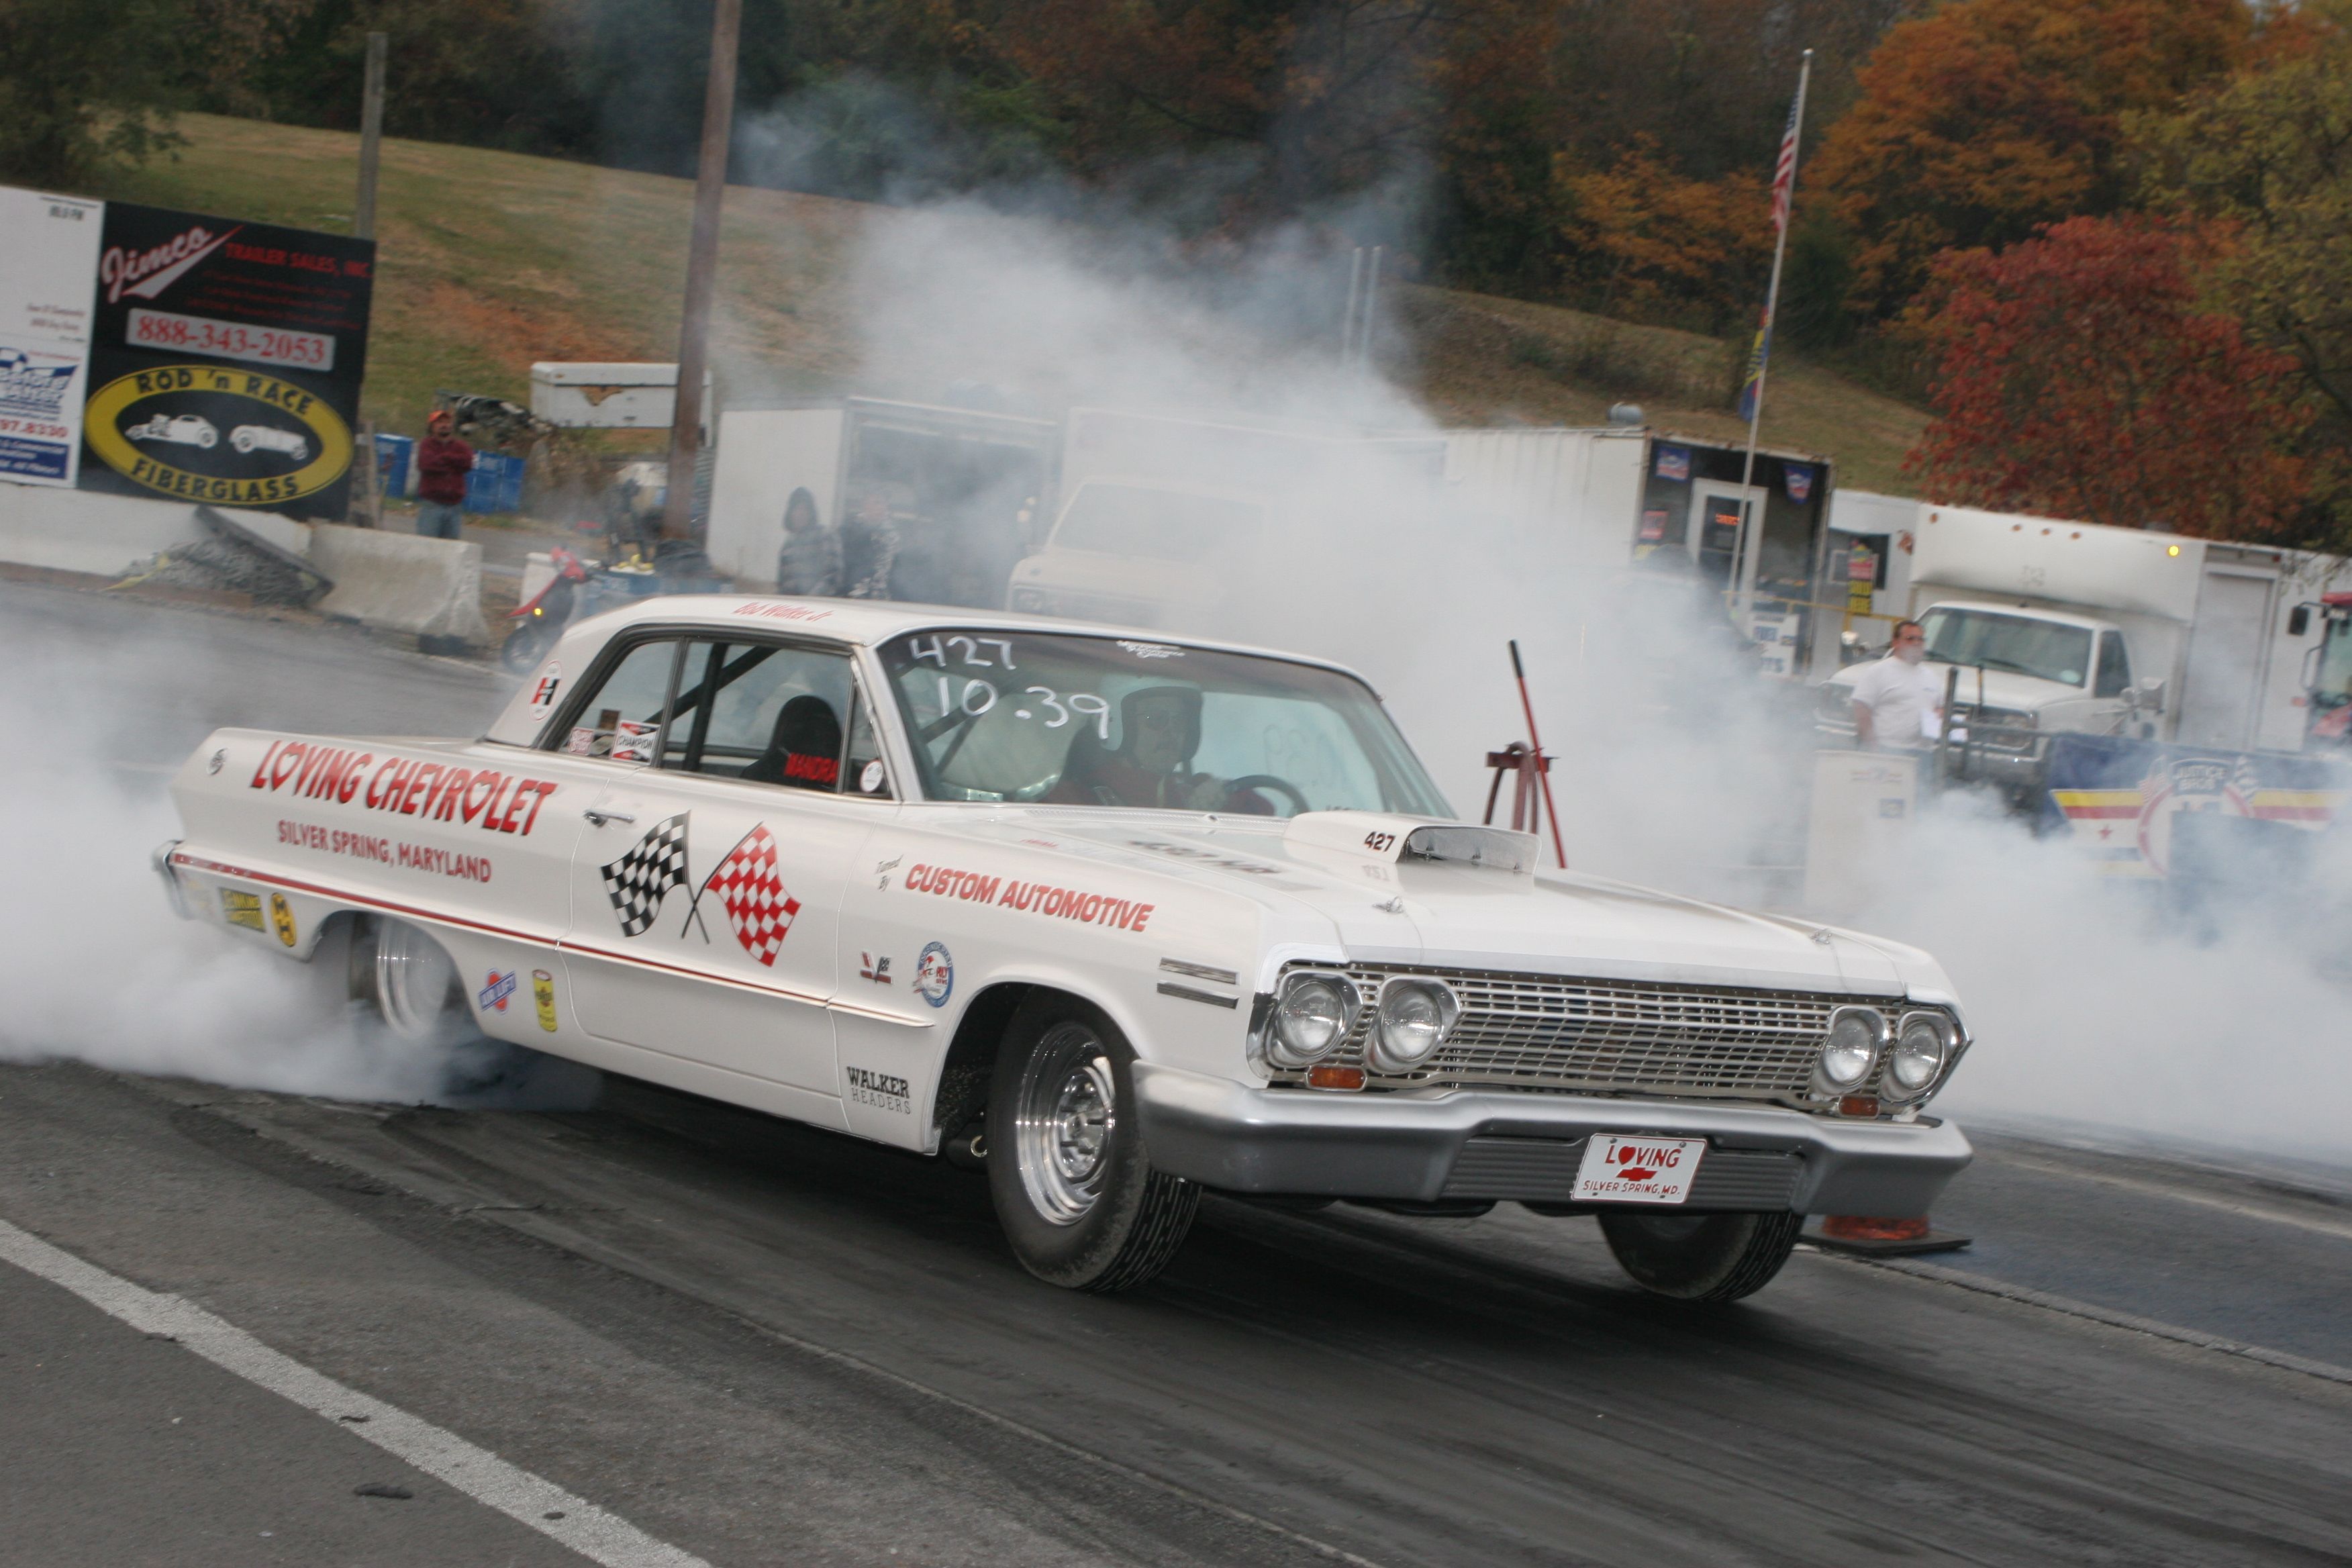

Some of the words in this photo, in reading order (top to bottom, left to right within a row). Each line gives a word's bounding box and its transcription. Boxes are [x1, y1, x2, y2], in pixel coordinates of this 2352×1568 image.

[102, 226, 214, 304] Jimco
[226, 242, 287, 266] TRAILER
[137, 315, 325, 364] 888-343-2053
[137, 369, 193, 394] ROD
[245, 375, 315, 415] RACE
[130, 458, 297, 501] FIBERGLASS
[910, 636, 1017, 671] 427
[938, 677, 1111, 740] 10.39
[250, 739, 373, 804] LOVING
[366, 756, 558, 836] CHEVROLET
[279, 819, 329, 850] SILVER
[332, 829, 395, 868] SPRING,
[397, 842, 491, 883] MARYLAND
[1363, 831, 1396, 852] 427
[904, 863, 1002, 904] CUSTOM
[997, 879, 1156, 932] AUTOMOTIVE
[846, 1066, 910, 1099] WALKER
[850, 1087, 912, 1115] HEADERS
[1605, 1145, 1681, 1168] LOVING
[1583, 1179, 1620, 1192] SILVER
